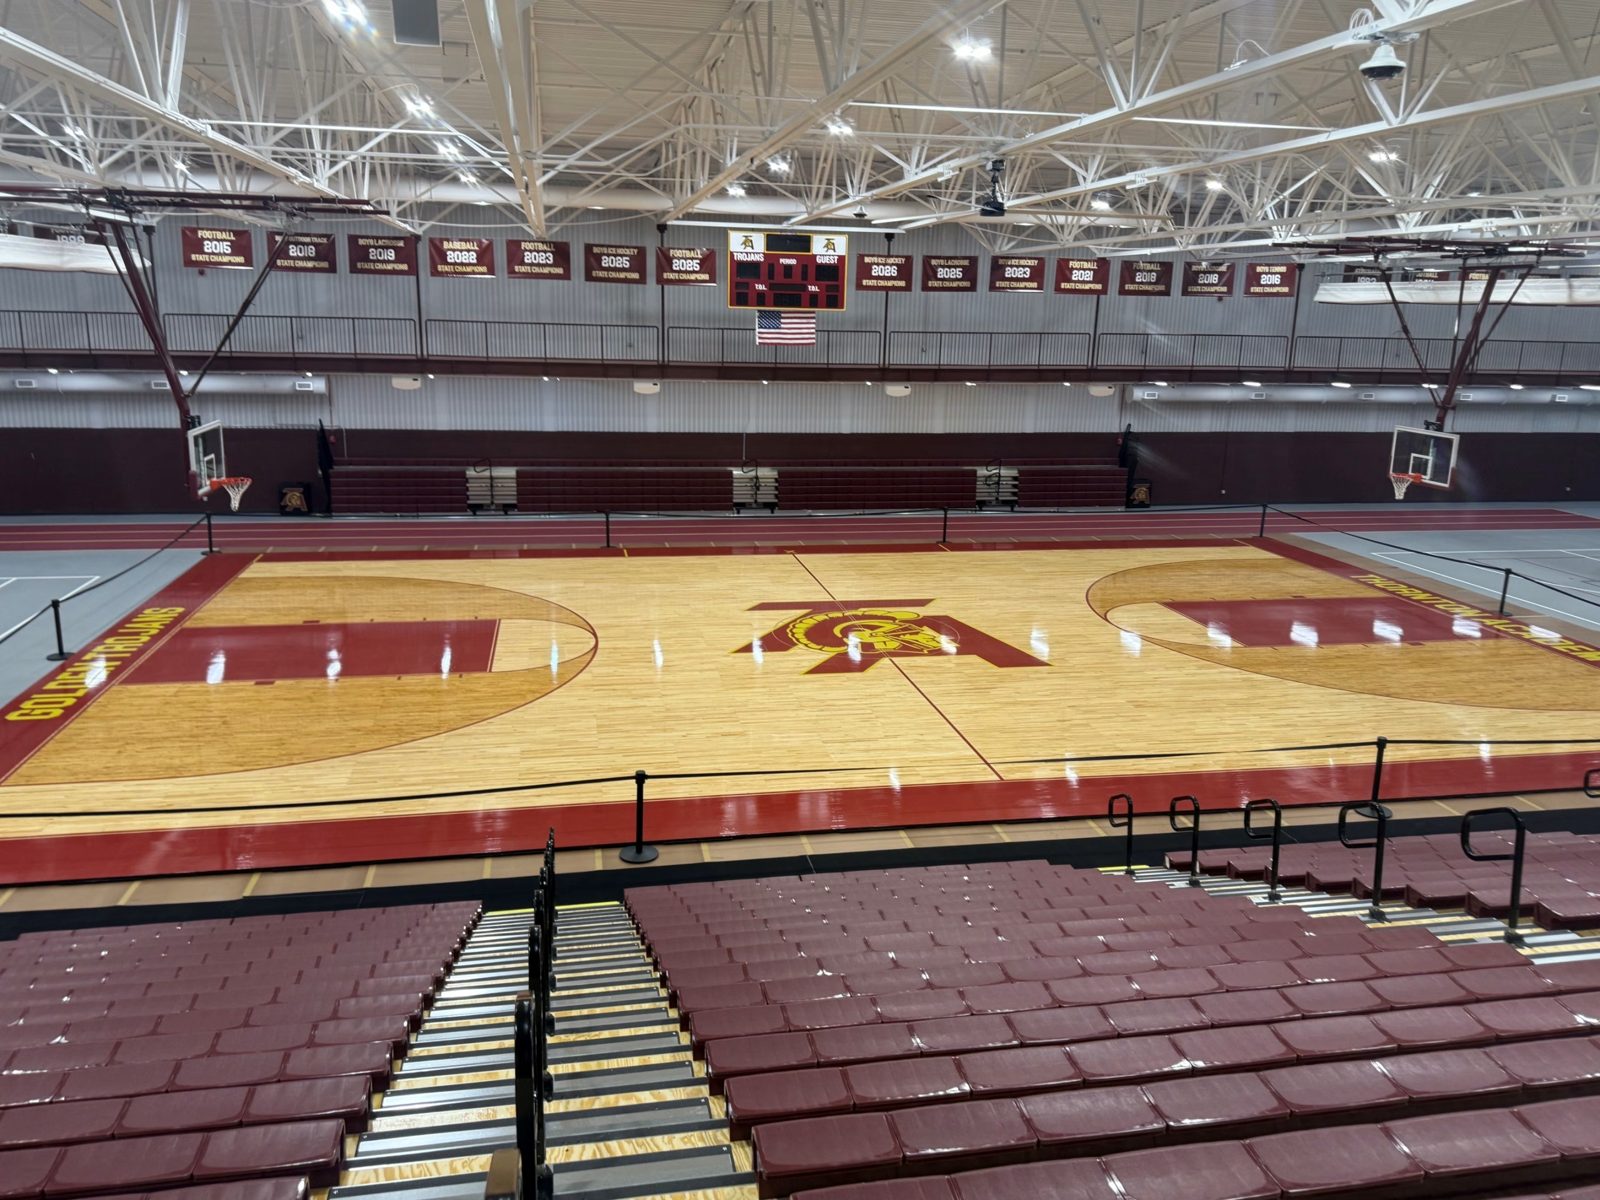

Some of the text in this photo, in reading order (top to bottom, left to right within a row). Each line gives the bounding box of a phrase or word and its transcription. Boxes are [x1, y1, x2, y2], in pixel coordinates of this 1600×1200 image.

[198, 230, 235, 240] FOOTBALL
[203, 241, 231, 253] 2015
[443, 241, 479, 250] BASEBALL
[521, 242, 555, 251] FOOTBALL
[289, 245, 315, 257] 2018
[369, 249, 395, 260] 2019
[670, 249, 702, 258] FOOTBALL
[191, 254, 244, 263] STATE CHAMPIONS
[446, 251, 477, 263] 2022
[524, 252, 553, 264] 2023
[601, 256, 630, 268] 2025
[733, 253, 764, 261] TROJANS
[816, 256, 838, 264] GUEST
[276, 259, 329, 268] STATE CHAMPIONS
[357, 262, 408, 271] STATE CHAMPIONS
[672, 259, 700, 271] 2025
[1069, 261, 1098, 269] FOOTBALL
[1133, 262, 1161, 270] FOOTBALL
[455, 265, 487, 273] CHAMPIONS
[514, 265, 563, 274] STATE CHAMPIONS
[872, 265, 898, 276] 2026
[937, 268, 963, 278] 2025
[1005, 267, 1030, 278] 2023
[592, 270, 639, 279] STATE CHAMPIONS
[1072, 270, 1093, 281] 2021
[1136, 272, 1156, 282] 2018
[1198, 274, 1218, 284] 2018
[1260, 274, 1281, 284] 2016
[1350, 574, 1492, 618] THORNTON
[5, 607, 186, 721] GOLDEN TROJANS
